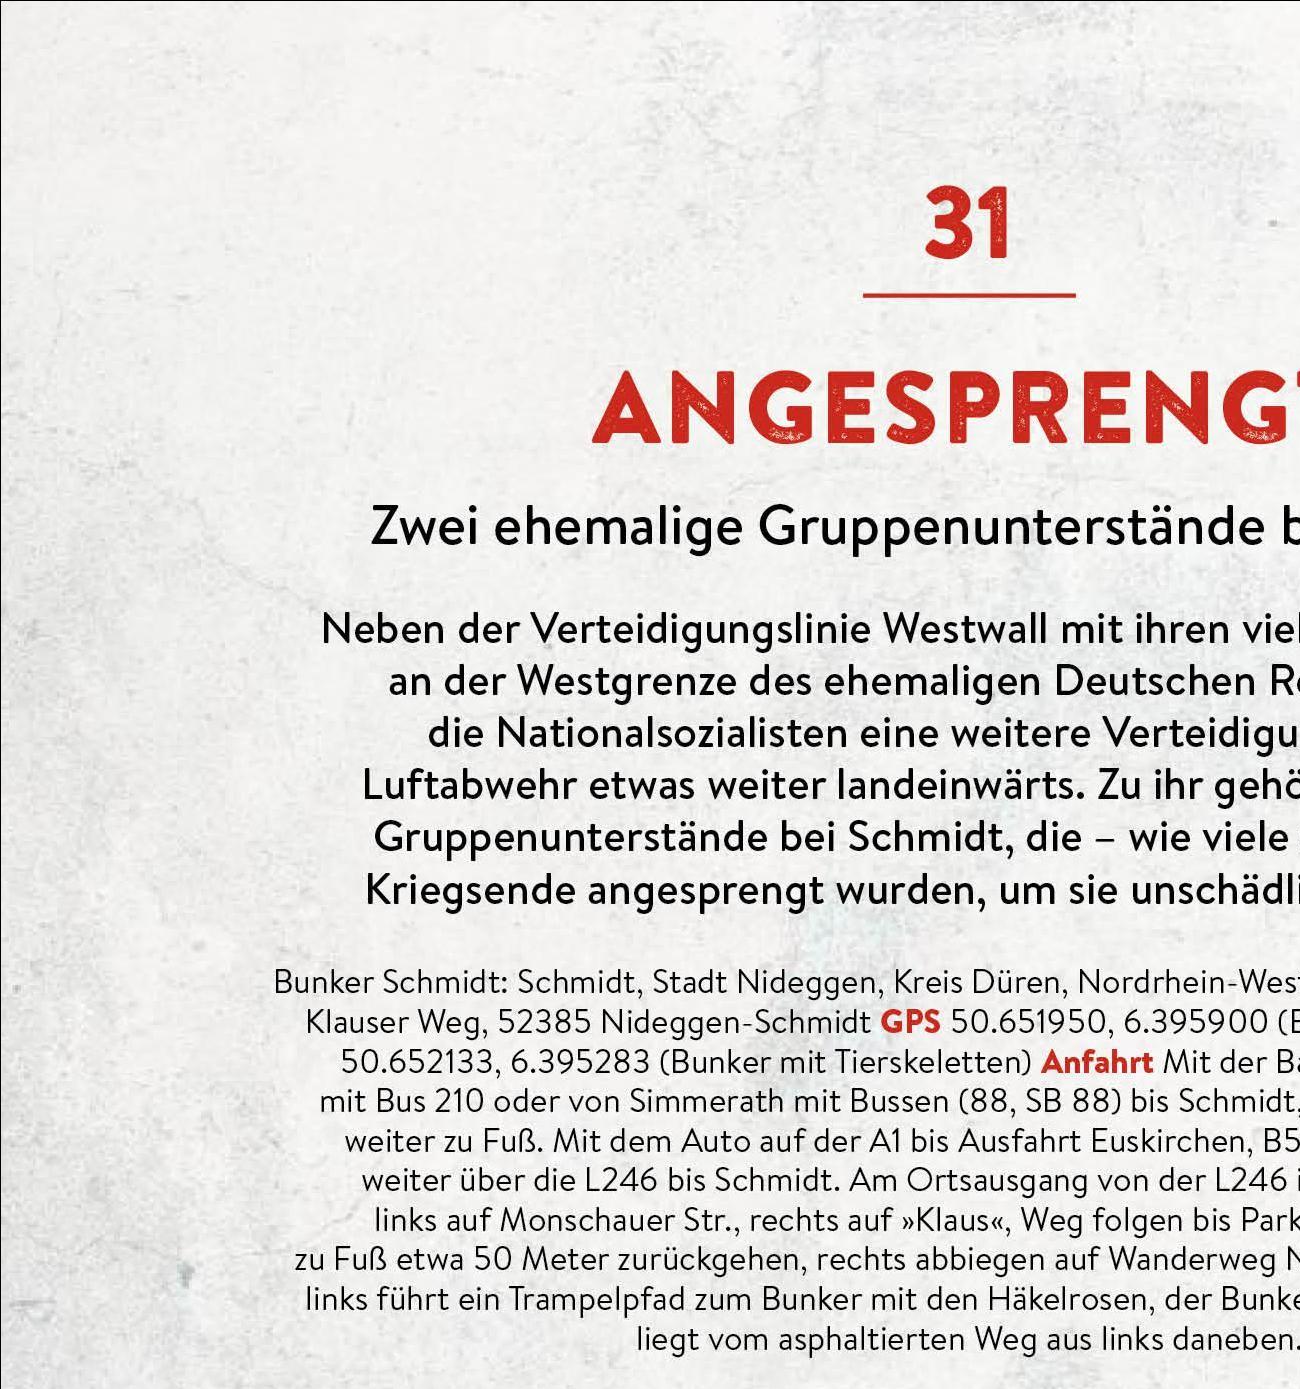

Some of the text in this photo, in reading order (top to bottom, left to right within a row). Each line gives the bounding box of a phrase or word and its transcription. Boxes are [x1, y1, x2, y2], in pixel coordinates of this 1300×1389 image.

[925, 185, 1007, 259] 31
[372, 505, 476, 545] Zwei
[495, 505, 742, 556] ehemalige
[760, 504, 1264, 557] Gruppenunterstände
[324, 612, 443, 643] Neben
[459, 612, 520, 643] der
[530, 612, 870, 653] Verteidigungslinie
[883, 612, 1046, 643] Westwall
[1063, 613, 1123, 643] mit
[1136, 612, 1228, 643] ihren
[429, 716, 483, 747] die
[499, 716, 846, 747] Nationalsozialisten
[861, 717, 938, 747] eine
[951, 717, 1090, 747] weitere
[365, 768, 577, 799] Luftabwehr
[590, 772, 694, 799] etwas
[708, 769, 826, 799] weiter
[839, 768, 1084, 799] landeinwärts.
[1098, 768, 1140, 799] Zu
[1155, 768, 1203, 799] ihr
[368, 873, 575, 914] Kriegsende
[589, 877, 824, 914] angesprengt
[836, 873, 985, 912] wurden,
[1001, 883, 1055, 904] um
[1070, 874, 1117, 904] sie
[276, 969, 374, 993] Bunker
[384, 969, 507, 993] Schmidt:
[519, 969, 642, 999] Schmidt,
[654, 969, 727, 993] Stadt
[739, 969, 883, 1000] Nideggen,
[896, 969, 962, 993] Kreis
[974, 969, 1067, 999] Düren,
[343, 1049, 500, 1079] 50.652133,
[512, 1049, 648, 1074] 6.395283
[661, 1049, 771, 1076] (Bunker
[781, 1050, 826, 1073] mit
[835, 1049, 1030, 1075] Tierskeletten)
[1041, 1049, 1153, 1073] Anfahrt
[1164, 1049, 1211, 1073] Mit
[1221, 1049, 1267, 1073] der
[638, 1326, 1300, 1358] liegt vom asphaltierten Weg aus links daneben.
